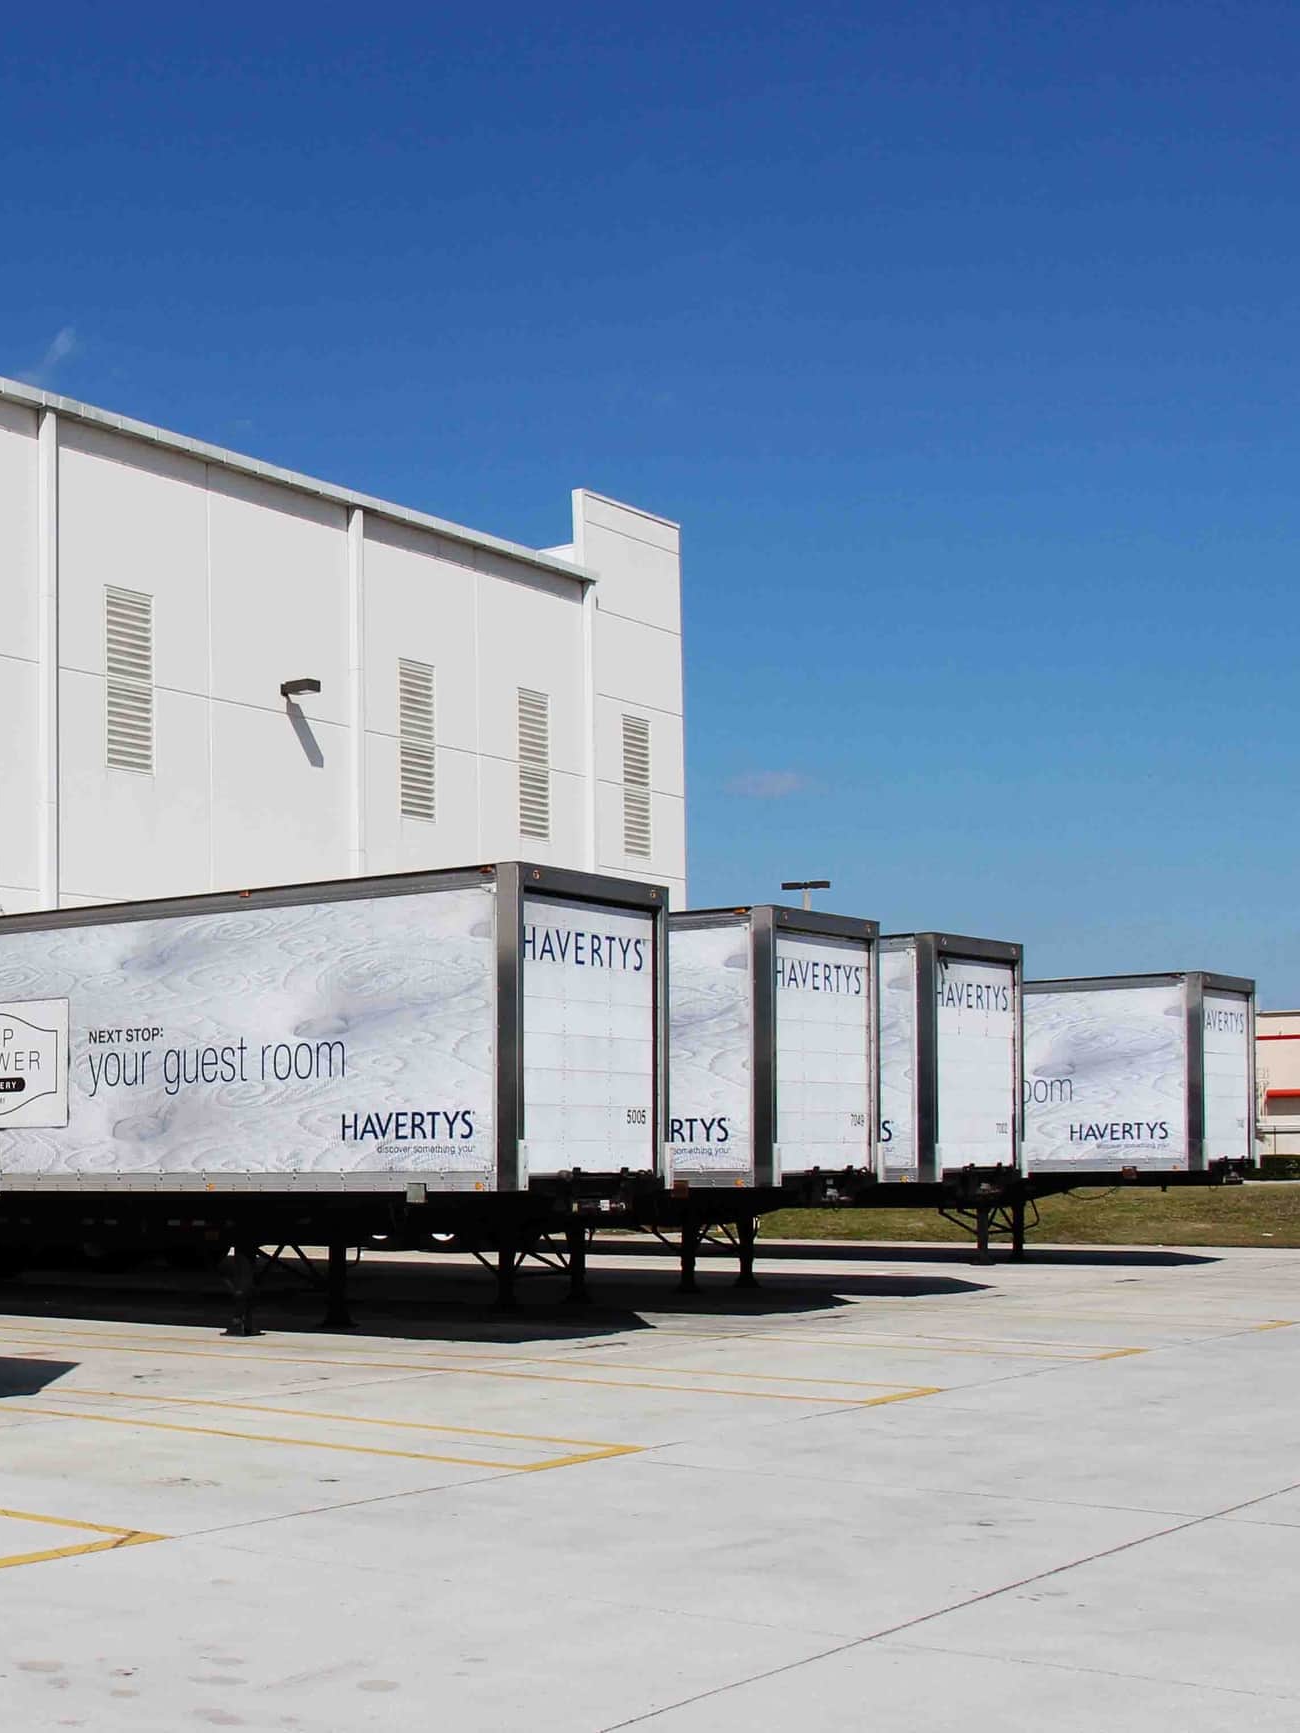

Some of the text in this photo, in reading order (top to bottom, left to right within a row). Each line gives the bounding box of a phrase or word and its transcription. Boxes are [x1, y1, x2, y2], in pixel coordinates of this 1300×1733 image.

[523, 926, 643, 972] HAVERTYS
[776, 957, 861, 995] HAVERTYS
[937, 982, 1008, 1011] HAVERTYS
[1204, 1009, 1244, 1033] AVERTYS
[88, 1027, 164, 1044] NEXT STOP:
[89, 1037, 346, 1097] your guest room
[341, 1110, 475, 1141] HAVERTYS
[626, 1109, 646, 1125] 5005
[1069, 1121, 1169, 1141] HAVERTYS
[377, 1144, 410, 1154] discover
[413, 1143, 456, 1155] something
